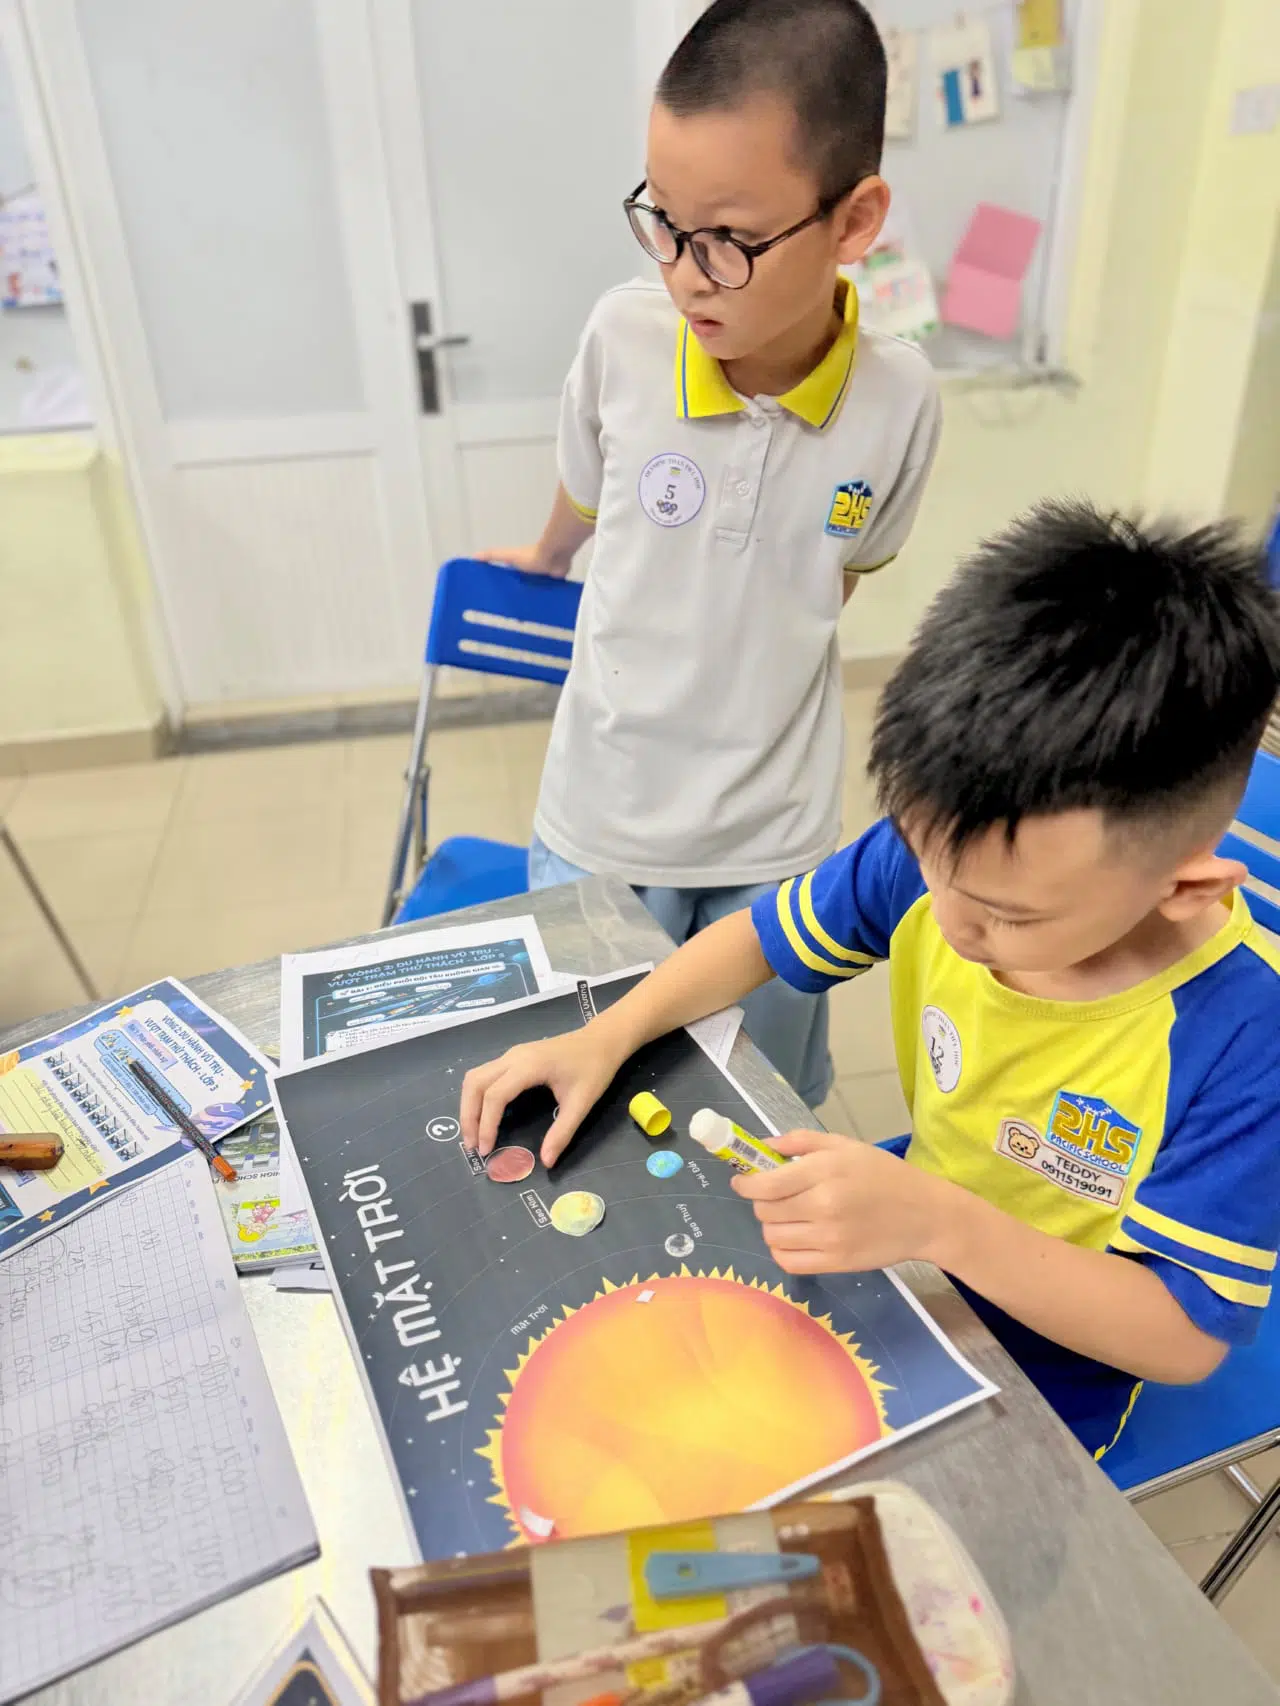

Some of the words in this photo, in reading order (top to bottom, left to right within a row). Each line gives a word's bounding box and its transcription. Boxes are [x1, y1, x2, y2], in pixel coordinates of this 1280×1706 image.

[665, 484, 676, 500] 5
[1055, 1155, 1101, 1183] TEDDY
[1082, 1150, 1125, 1173] SCHOOL
[1041, 1160, 1113, 1198] 0911519091
[338, 1163, 405, 1254] TRỜI
[535, 1207, 548, 1225] Sao
[689, 1221, 703, 1239] Sao
[372, 1259, 443, 1348] MẶT
[398, 1353, 470, 1423] HỆ
